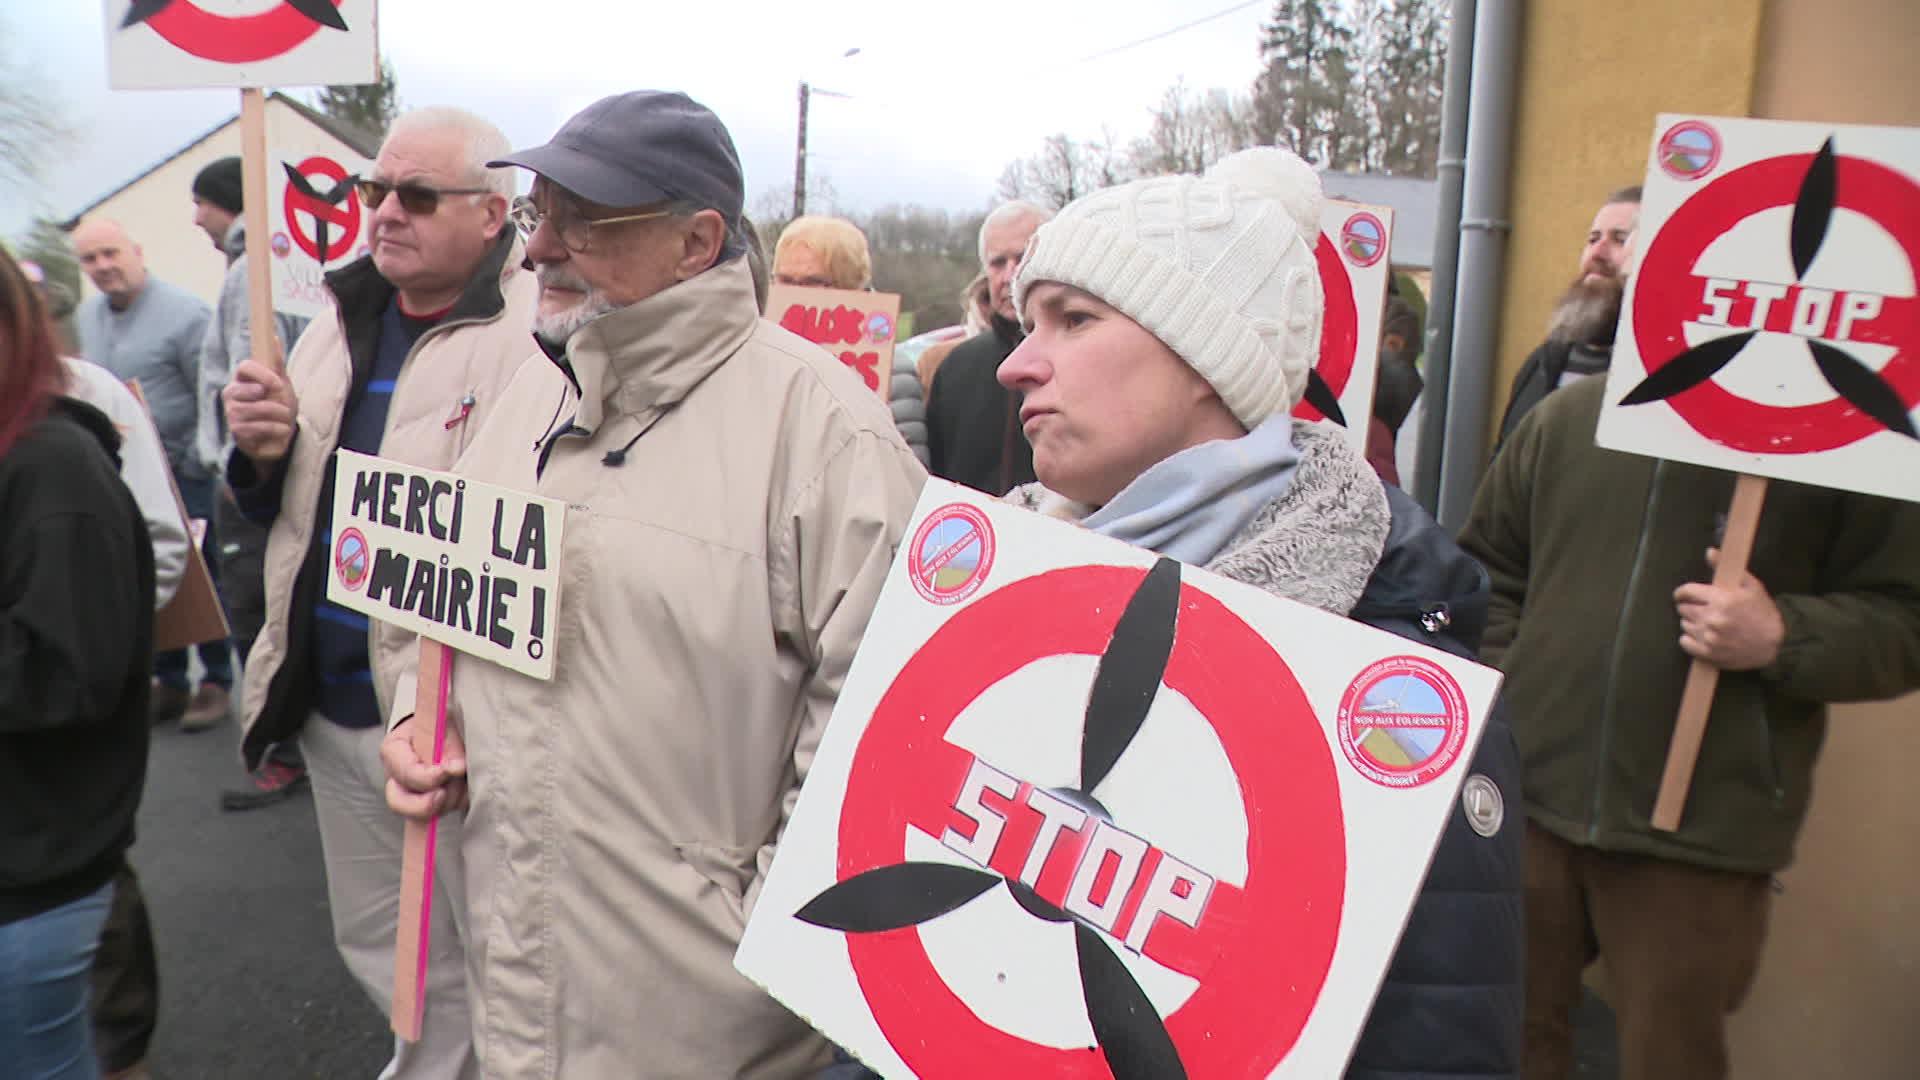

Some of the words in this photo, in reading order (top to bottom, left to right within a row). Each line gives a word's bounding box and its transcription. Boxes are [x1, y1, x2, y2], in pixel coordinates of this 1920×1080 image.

[1698, 278, 1884, 341] STOP
[491, 497, 547, 570] LA
[940, 756, 1215, 958] STOP
